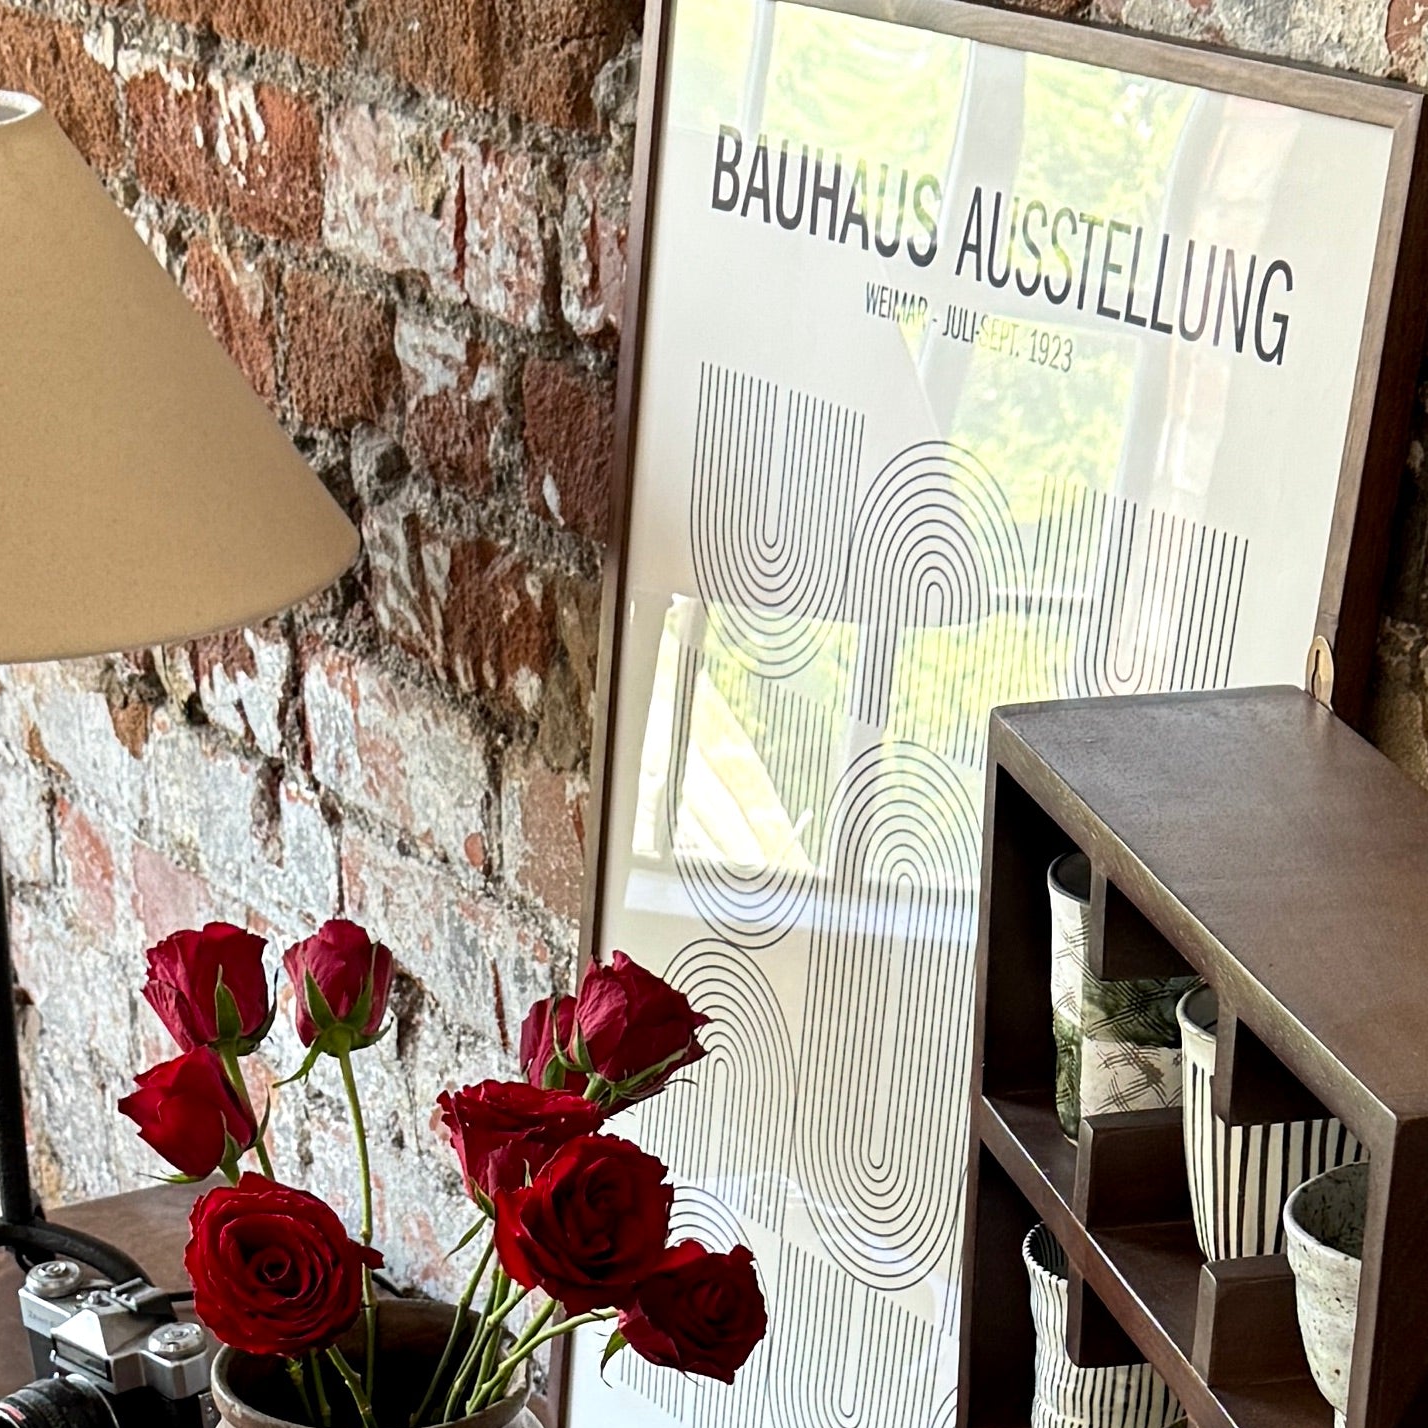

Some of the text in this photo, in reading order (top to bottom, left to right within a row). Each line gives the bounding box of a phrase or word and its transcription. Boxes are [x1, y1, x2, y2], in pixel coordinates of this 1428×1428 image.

[711, 123, 1294, 366] BAUHAUS AUSSTELLUNG
[865, 281, 929, 329] WEIMAR
[1028, 328, 1074, 373] 1923
